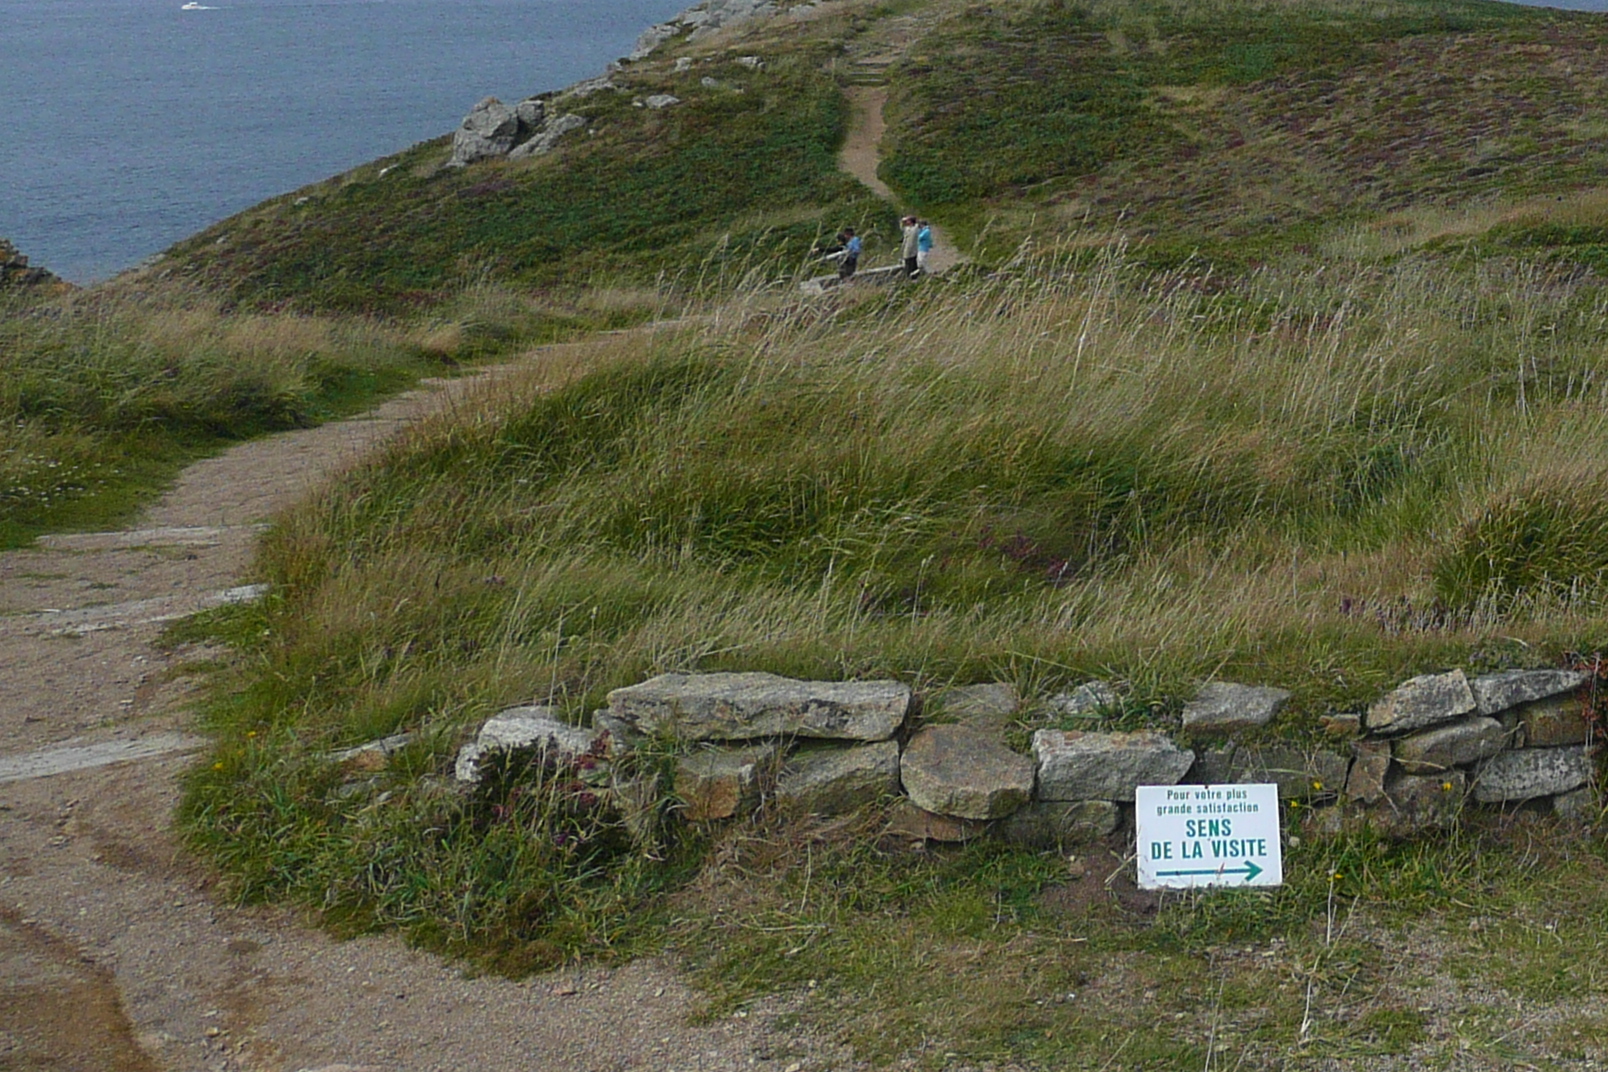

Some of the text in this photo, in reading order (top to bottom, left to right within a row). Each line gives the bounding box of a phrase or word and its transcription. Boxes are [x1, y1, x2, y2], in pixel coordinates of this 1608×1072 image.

[1167, 788, 1247, 800] Pour votre plus
[1157, 803, 1259, 816] grande satisfaction
[1186, 818, 1232, 837] SENS
[1151, 839, 1267, 860] DE LA VISITE
